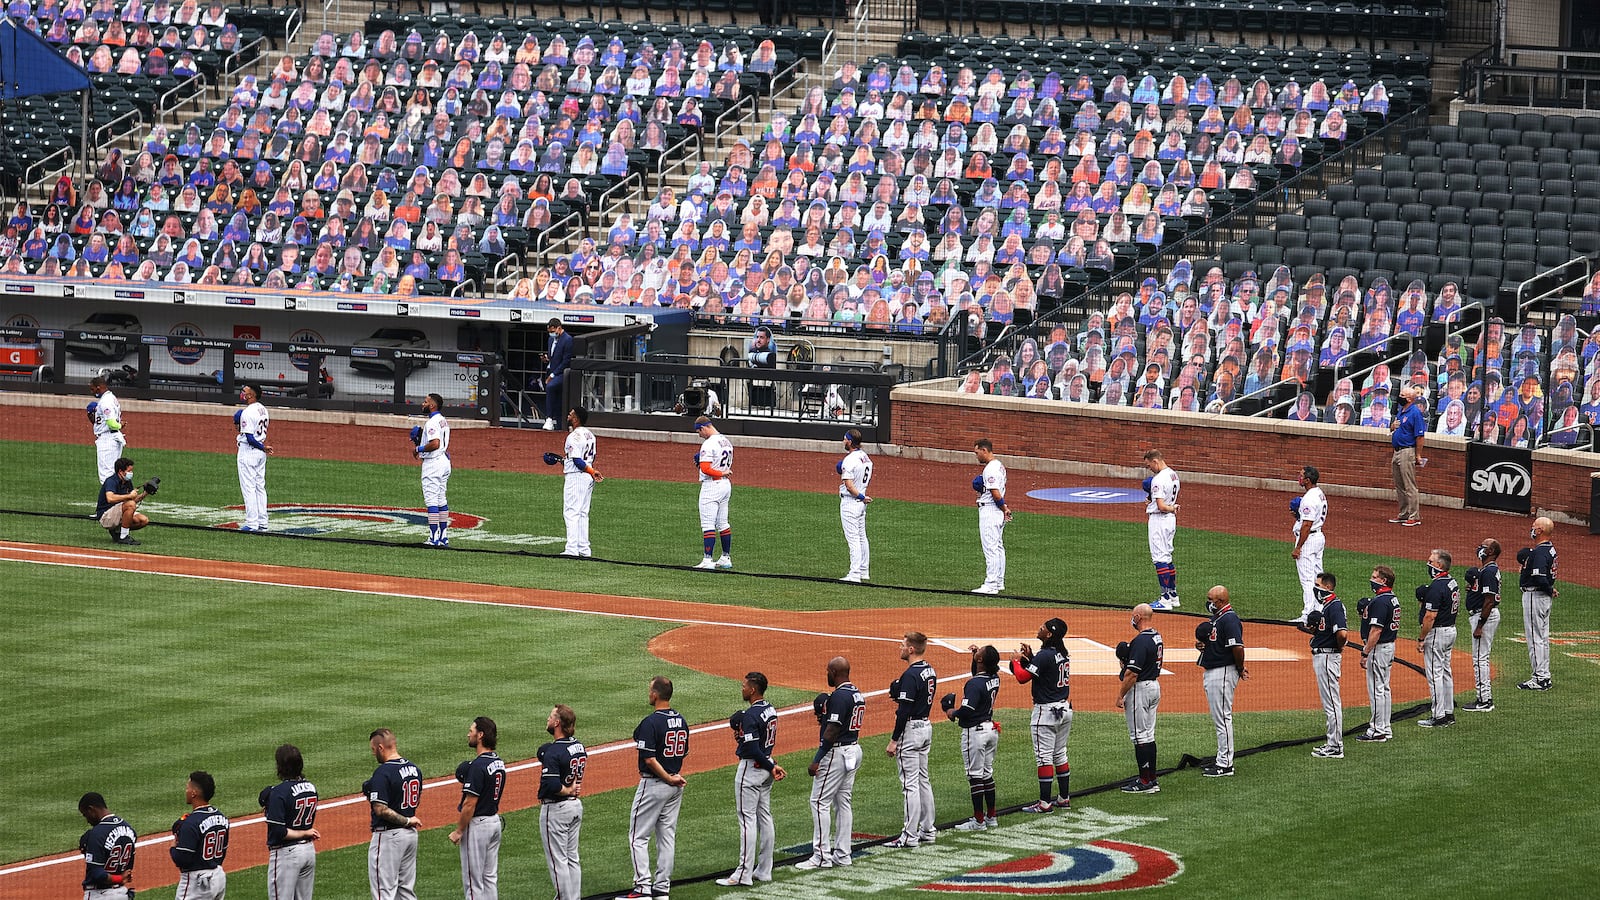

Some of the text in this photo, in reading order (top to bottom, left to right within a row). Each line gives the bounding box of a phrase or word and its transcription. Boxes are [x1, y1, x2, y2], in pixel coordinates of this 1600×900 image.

[10, 352, 20, 363] G
[234, 361, 265, 370] OYOTA
[862, 466, 870, 483] 6
[1471, 469, 1522, 495] SNY
[1056, 661, 1070, 688] 13
[662, 730, 688, 757] 56
[565, 756, 587, 784] 33
[401, 779, 419, 809] 18
[292, 796, 317, 827] 77
[104, 843, 133, 872] 24
[202, 829, 227, 861] 60
